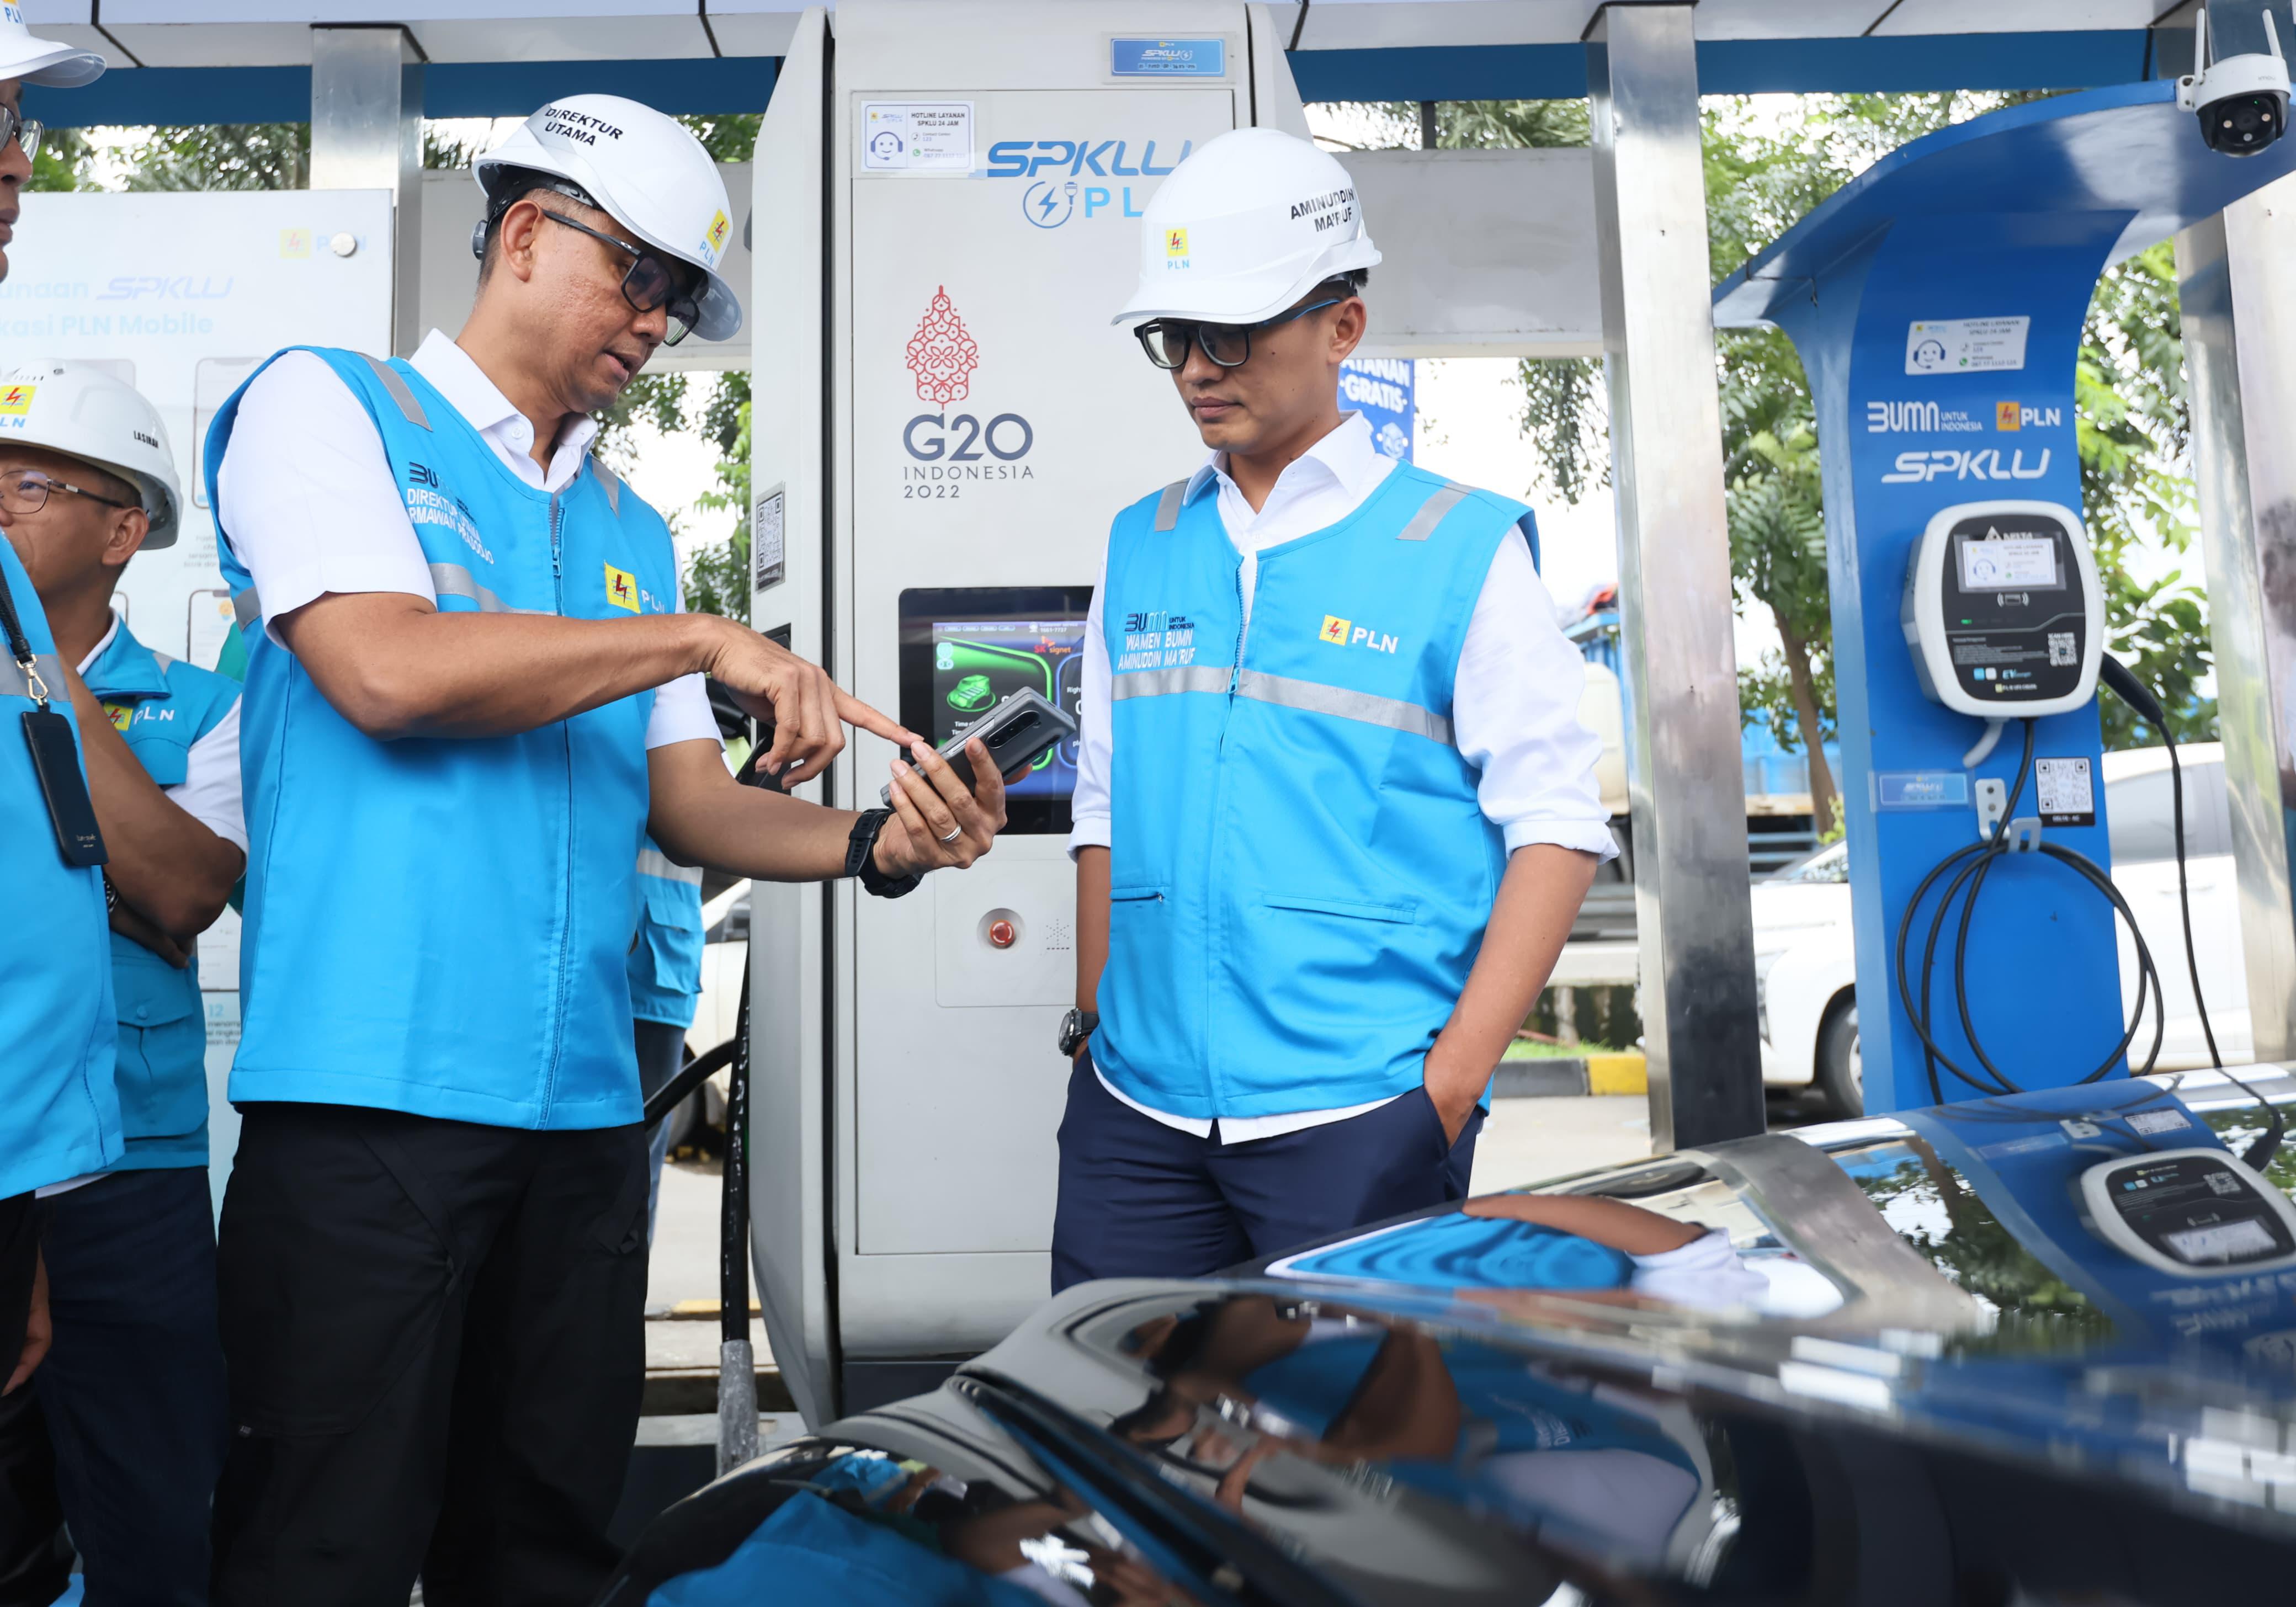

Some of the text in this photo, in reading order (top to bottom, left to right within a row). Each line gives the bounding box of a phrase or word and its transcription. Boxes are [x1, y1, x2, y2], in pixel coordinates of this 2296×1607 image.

[4, 7, 23, 24] PLN
[545, 108, 623, 140] DIREKTUR
[545, 121, 597, 146] UTAMA
[970, 140, 1193, 178] SPKLU
[1085, 187, 1144, 218] PL
[1291, 188, 1354, 220] AMINUDDIN
[1314, 207, 1352, 232] MA'RUF
[317, 235, 367, 252] PN
[699, 241, 715, 267] PLN
[1167, 259, 1189, 270] PLN
[95, 276, 234, 301] SPKLU
[62, 316, 110, 336] PLN
[119, 313, 214, 336] Mobile
[1344, 374, 1404, 414] GRATIS
[0, 417, 26, 428] LN
[1867, 401, 1968, 433] BUMN UNTUK
[1941, 422, 1983, 432] INDONESIA
[2020, 407, 2061, 427] PLN
[903, 413, 1033, 461] G20
[903, 465, 1034, 480] INDONESIA
[1881, 448, 2051, 484] SPKLU
[407, 488, 458, 517] DIREKTUR
[903, 485, 960, 498] 2022
[408, 507, 456, 531] RMAWAN
[1125, 611, 1168, 632] BUMN
[1034, 645, 1072, 655] SK signet
[1126, 630, 1193, 651] WAMEN BUMN
[1351, 626, 1399, 654] PLN
[1118, 647, 1196, 671] AMINUDDIN MA'RUF
[134, 706, 175, 725] PLN
[208, 1004, 224, 1018] 12
